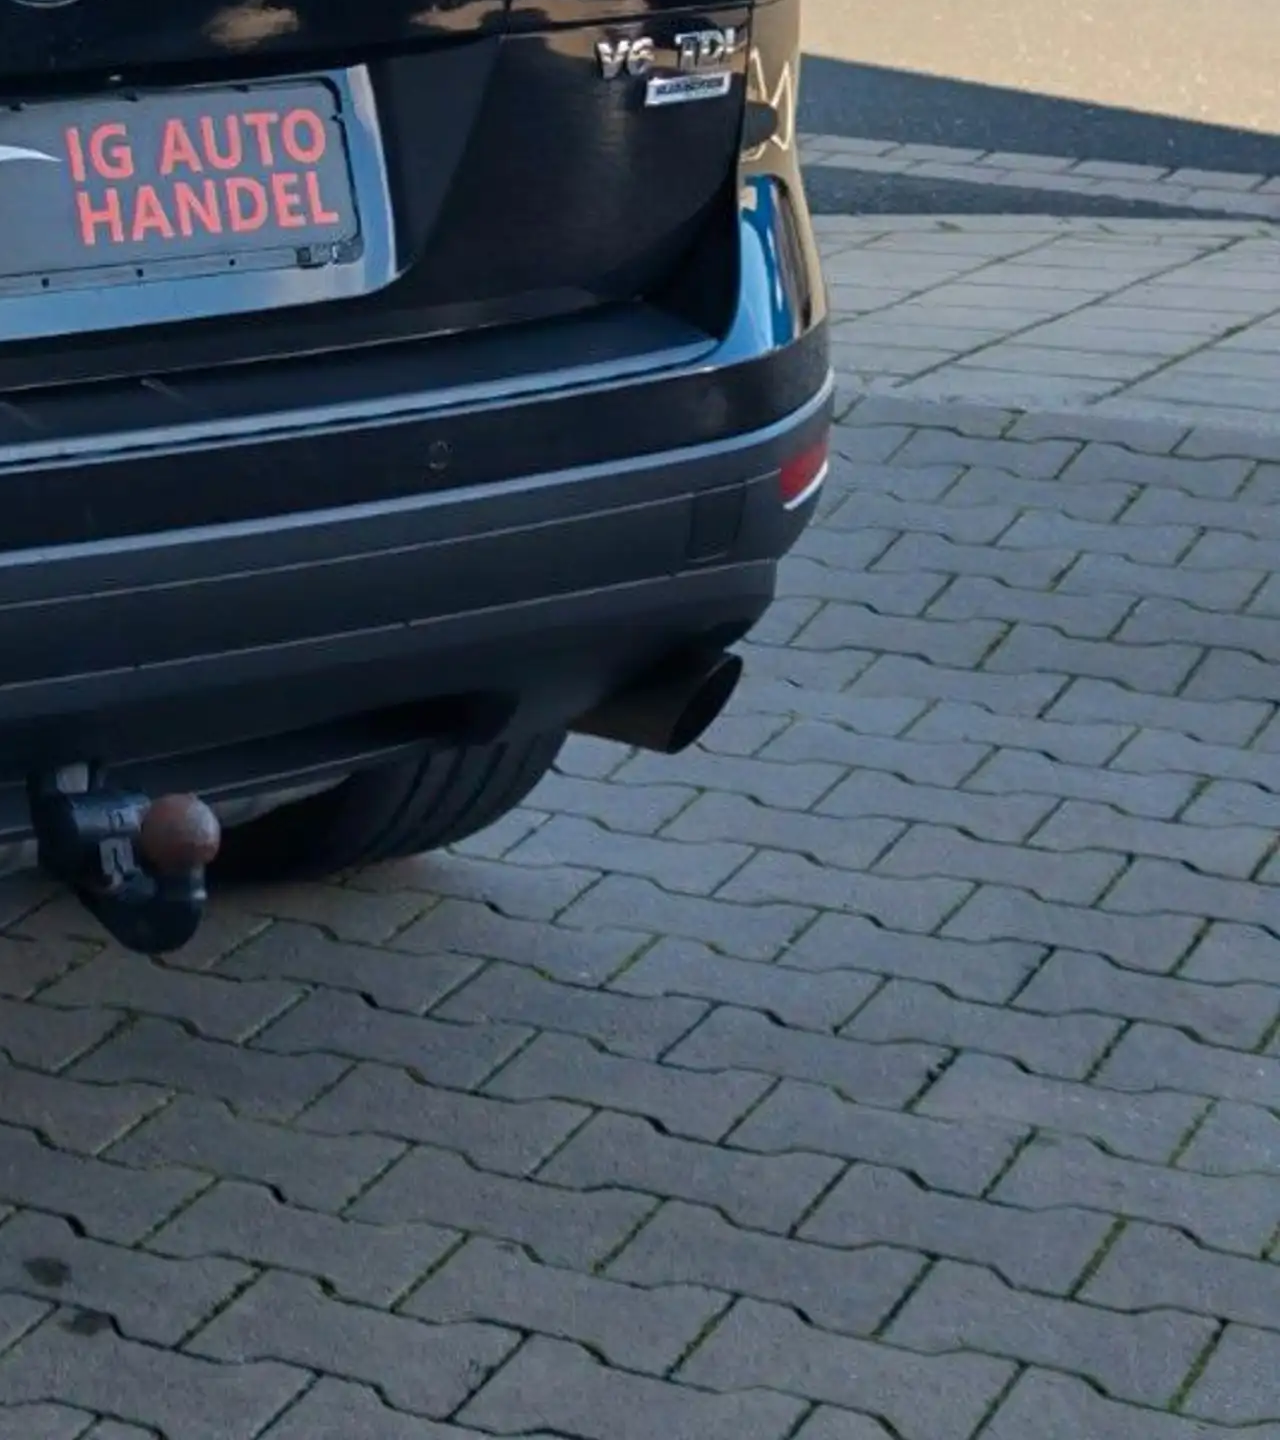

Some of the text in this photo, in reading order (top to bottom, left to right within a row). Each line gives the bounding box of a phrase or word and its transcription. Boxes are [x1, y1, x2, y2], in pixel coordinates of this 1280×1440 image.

[596, 27, 736, 78] V6 TDI
[65, 109, 327, 183] IG AUTO
[76, 170, 340, 246] HANDEL
